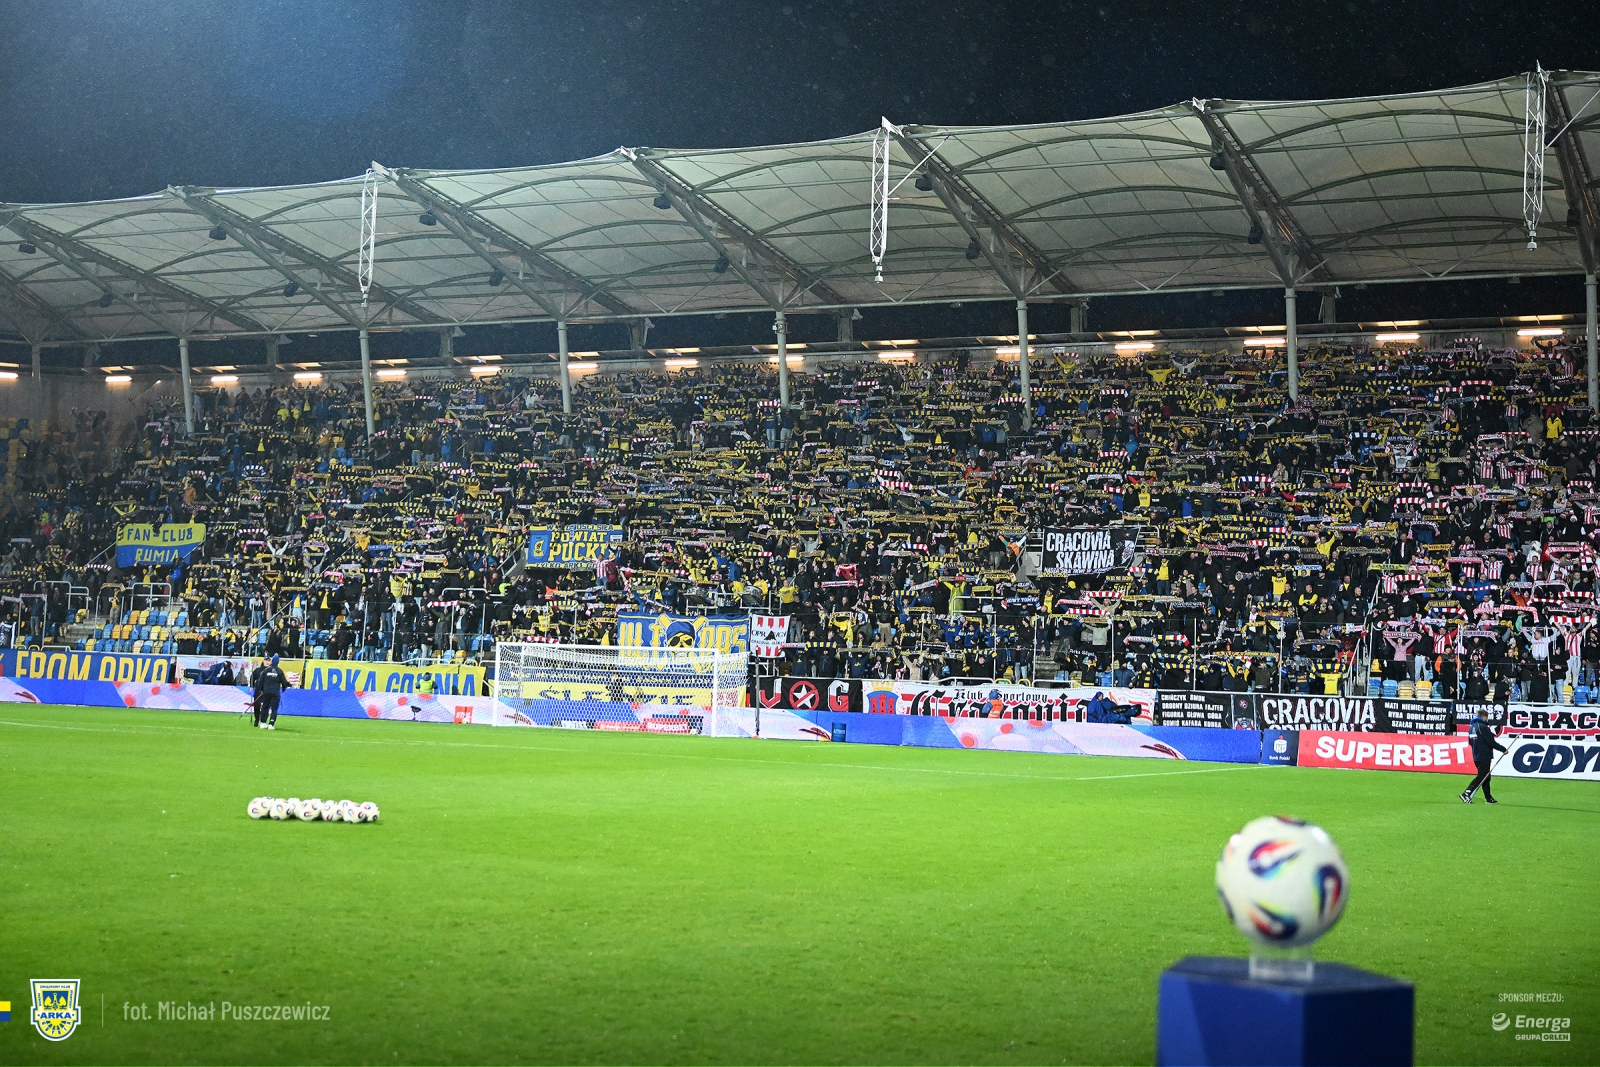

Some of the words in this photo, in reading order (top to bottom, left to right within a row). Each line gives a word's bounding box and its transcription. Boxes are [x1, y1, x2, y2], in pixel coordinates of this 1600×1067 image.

[551, 532, 608, 543] POWIAT
[1046, 531, 1112, 551] CRACOVIA
[135, 548, 179, 562] RUMIA
[1056, 549, 1115, 569] SKAWINA
[16, 650, 92, 681] FROM
[99, 656, 168, 684] ARKA
[310, 667, 377, 692] ARKA
[827, 680, 849, 712] G
[1384, 701, 1399, 710] MATI
[1402, 703, 1424, 711] NIEMIEC
[1262, 698, 1376, 725] CRACOVIA
[1455, 703, 1494, 713] ULTRAS
[1509, 710, 1600, 730] CRAC
[1315, 735, 1469, 767] SUPERBET
